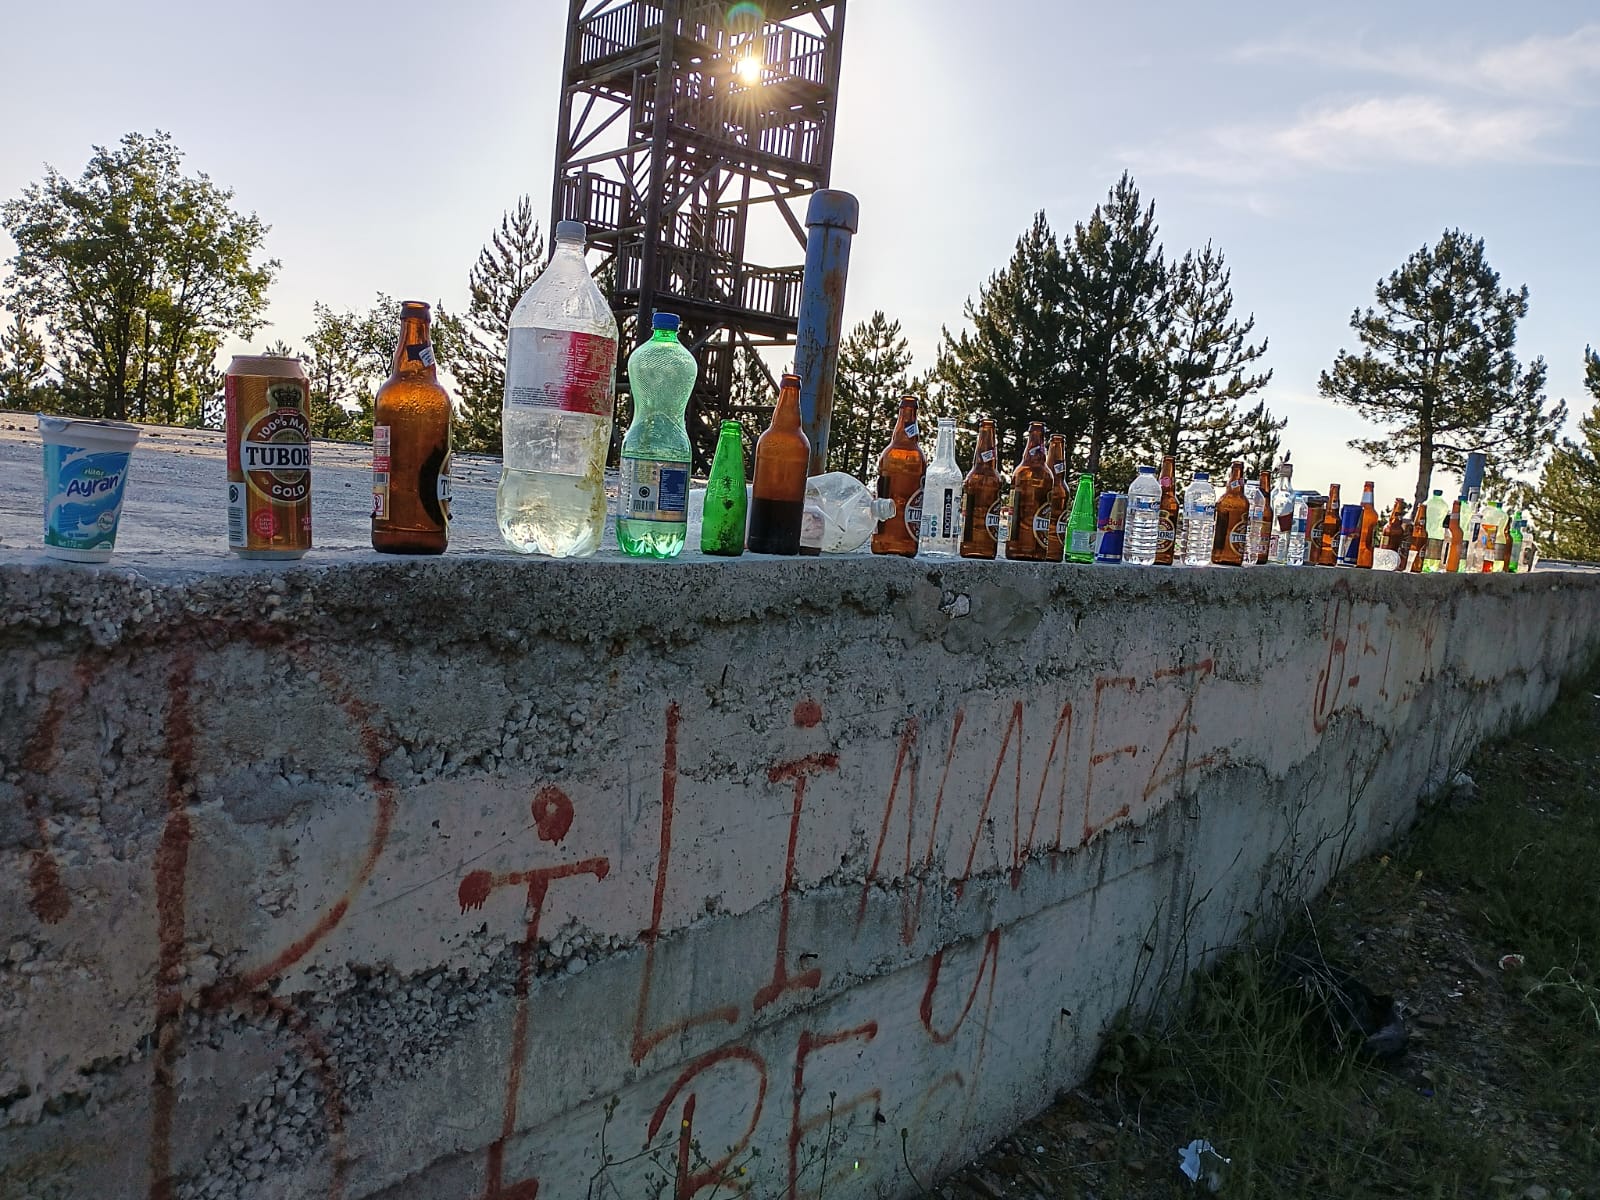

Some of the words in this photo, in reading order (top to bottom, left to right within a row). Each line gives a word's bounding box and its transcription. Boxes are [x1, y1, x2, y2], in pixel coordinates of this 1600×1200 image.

[257, 416, 288, 439] 100%
[66, 475, 119, 497] Ayran
[272, 484, 305, 498] GOLD
